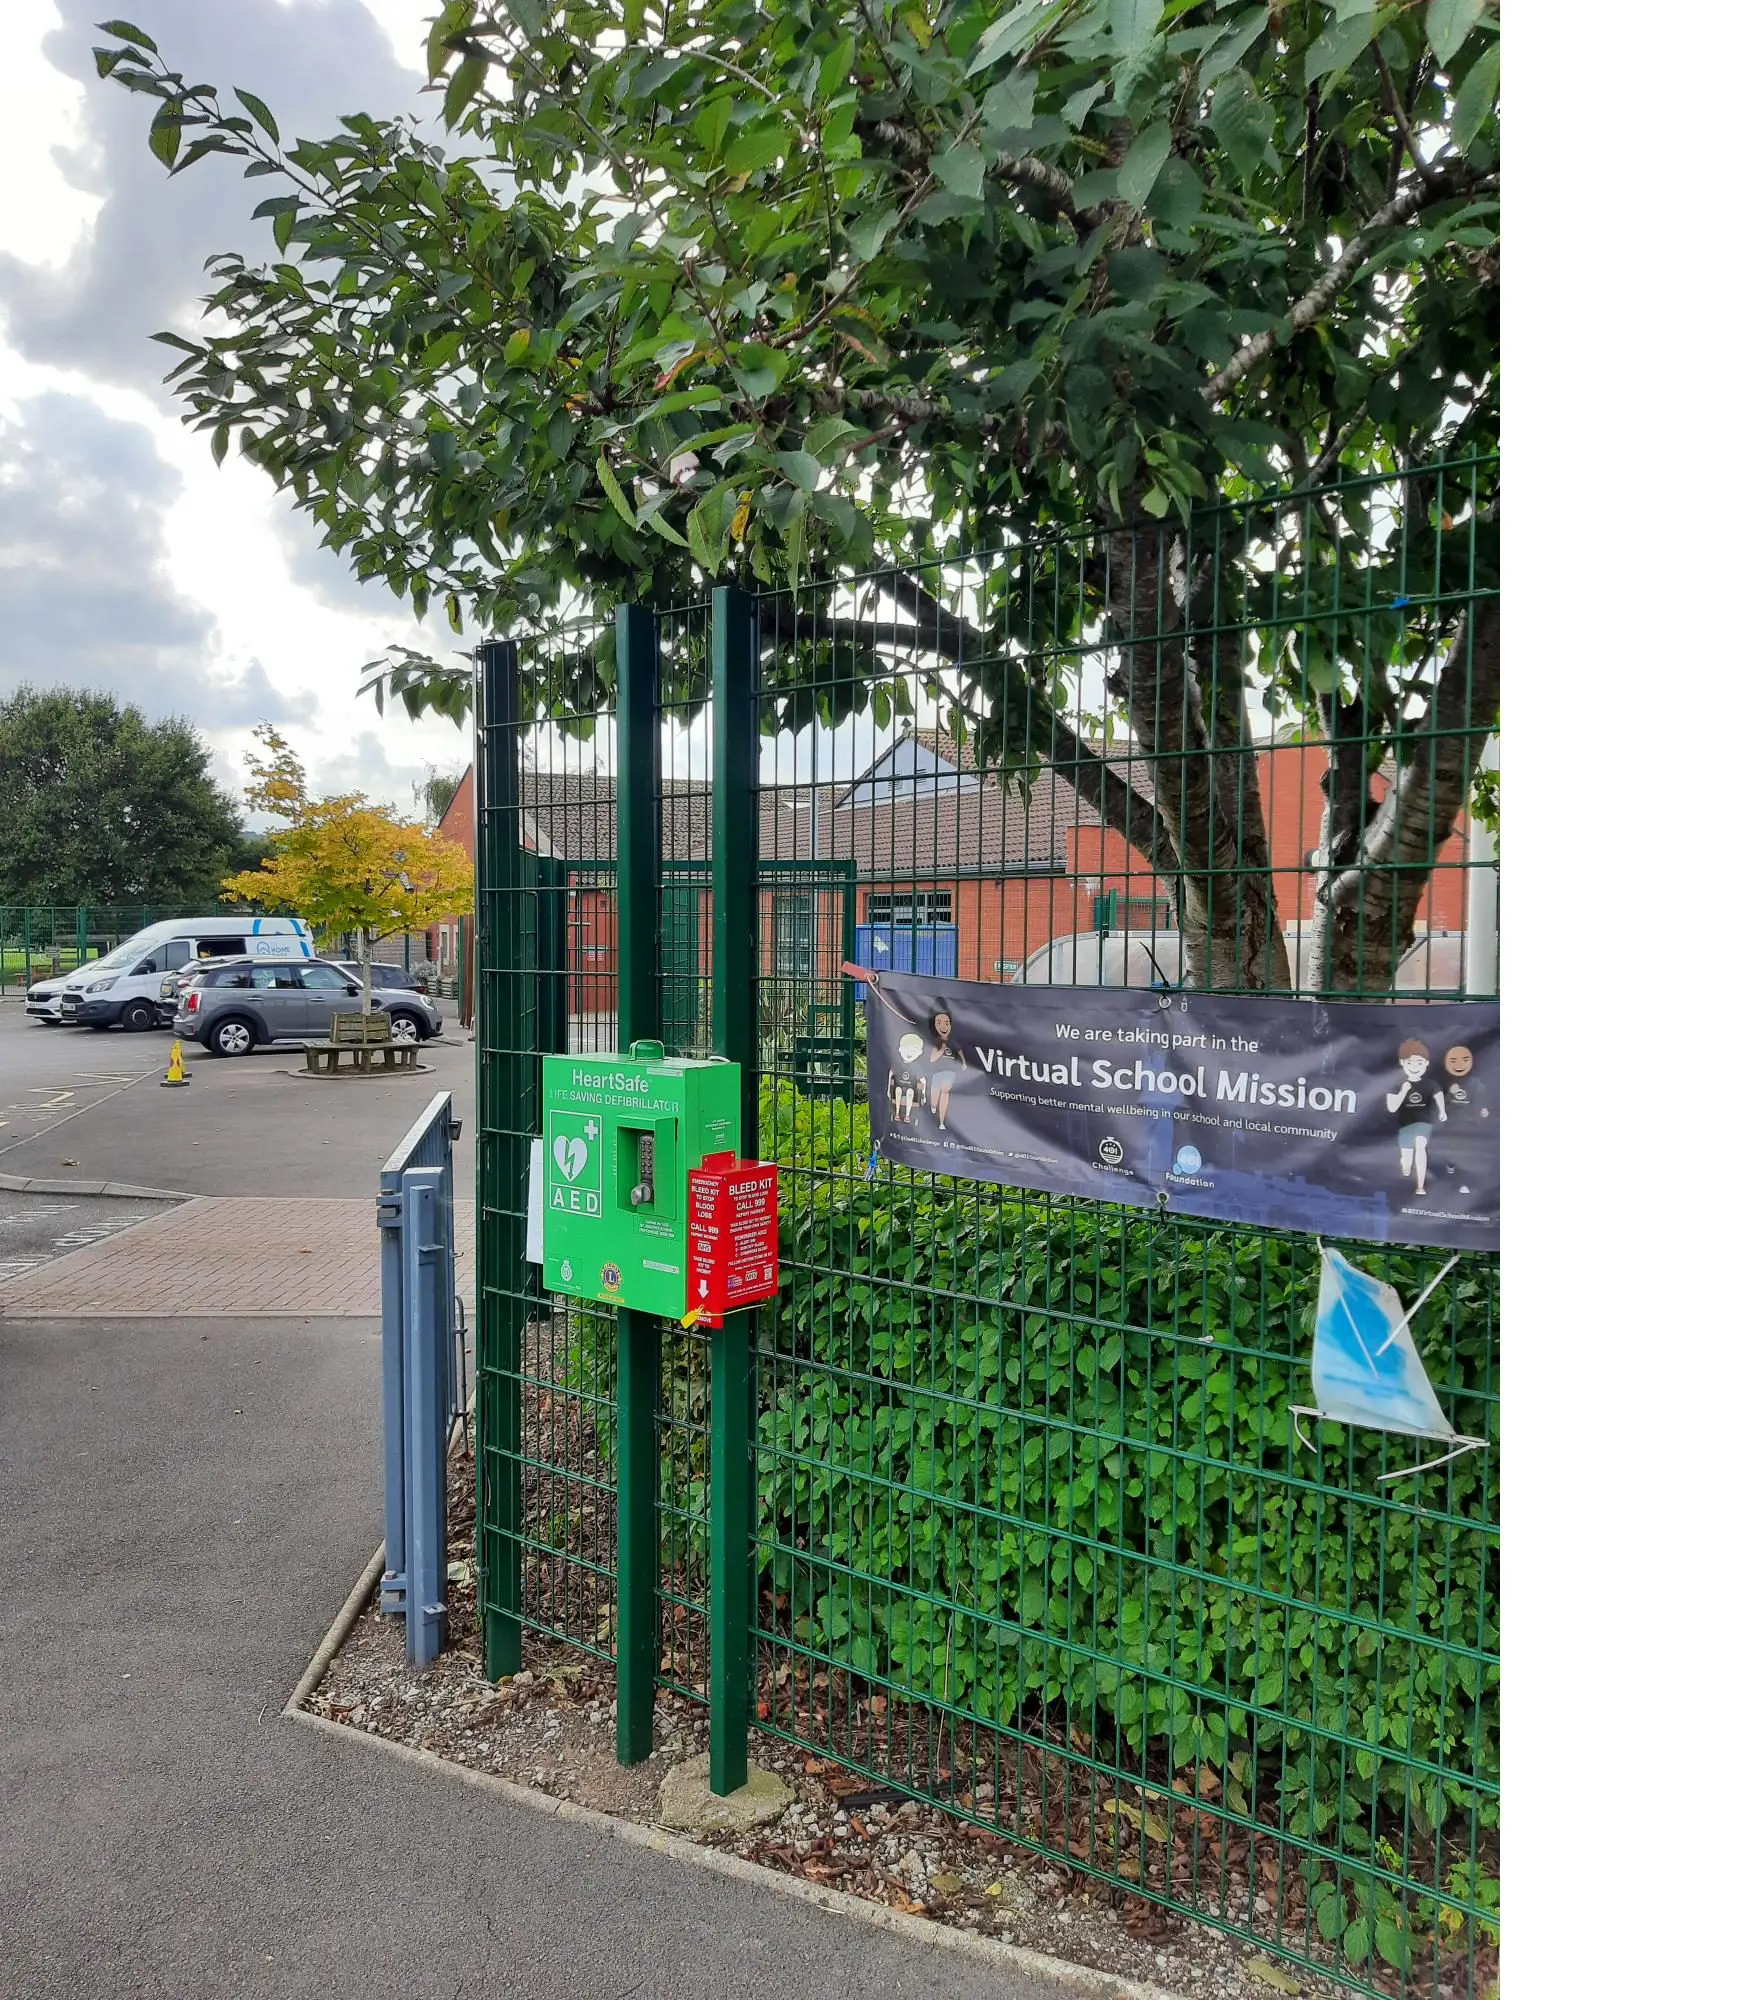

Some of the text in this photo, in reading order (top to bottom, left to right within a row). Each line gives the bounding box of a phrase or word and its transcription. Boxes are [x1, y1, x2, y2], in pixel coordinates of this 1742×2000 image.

[1056, 1024, 1259, 1053] We are taking part in the
[572, 1068, 649, 1093] HeartSafe
[975, 1046, 1357, 1114] Virtual School Mission
[570, 1090, 602, 1104] SAVING
[605, 1094, 679, 1112] DEFIBRILLATOR
[990, 1087, 1338, 1142] Supporting better mental wellbeing in our school and local community
[1103, 1146, 1118, 1155] 401
[1092, 1161, 1134, 1176] Challenge
[729, 1178, 772, 1196] BLEED KIT
[1166, 1172, 1215, 1188] Foundation
[692, 1186, 710, 1194] BLEED
[552, 1187, 598, 1214] AED
[696, 1202, 715, 1211] BLOOD
[736, 1198, 766, 1211] CALL 999
[698, 1211, 712, 1220] LOSS
[690, 1222, 719, 1234] CALL 999
